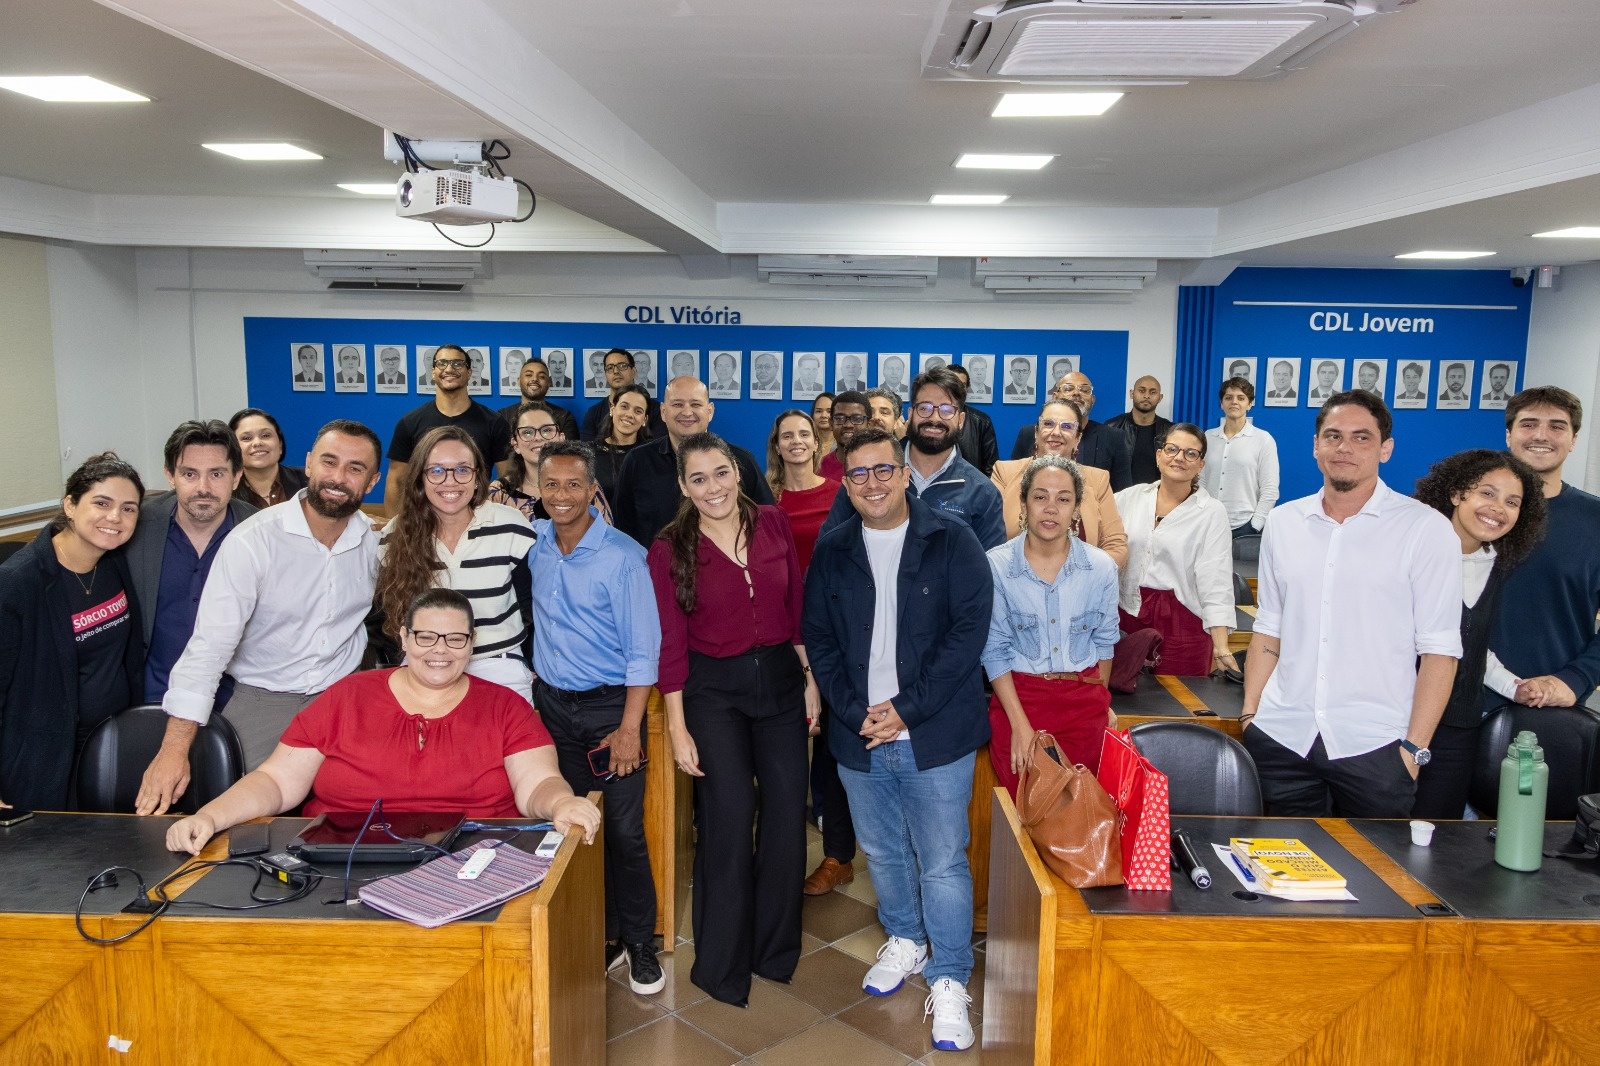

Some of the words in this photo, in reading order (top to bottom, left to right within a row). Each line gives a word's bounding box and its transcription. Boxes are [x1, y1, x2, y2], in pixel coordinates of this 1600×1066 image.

[624, 305, 664, 323] CDL
[670, 305, 741, 324] Vitória
[1309, 311, 1353, 332] CDL
[1359, 312, 1434, 333] Jovem
[73, 608, 107, 629] SÓRCIO
[80, 630, 95, 641] jeito
[94, 626, 103, 634] de
[102, 618, 125, 630] comprar
